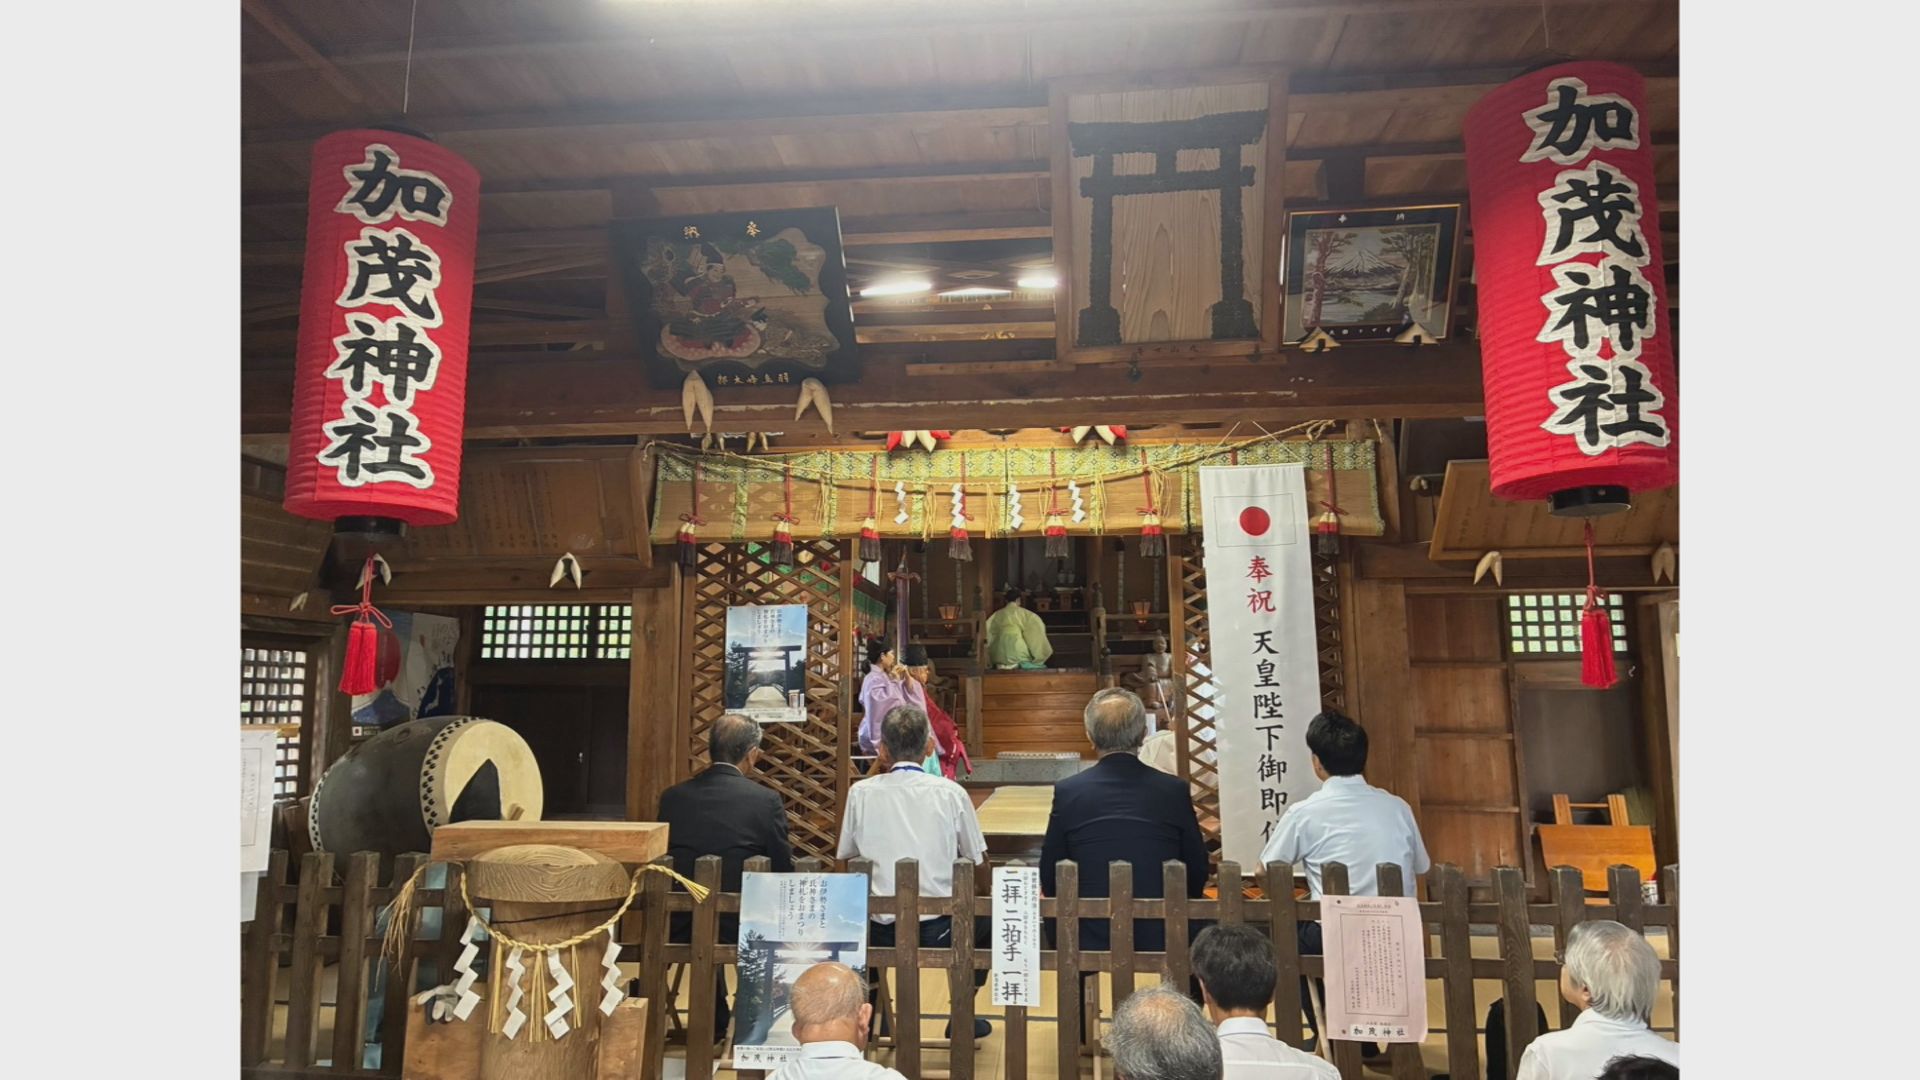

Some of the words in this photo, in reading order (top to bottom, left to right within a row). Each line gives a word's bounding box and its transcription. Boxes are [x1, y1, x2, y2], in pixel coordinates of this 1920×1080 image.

[325, 149, 447, 481] 加茂神社
[1536, 84, 1665, 447] 加茂神社
[1245, 554, 1276, 614] 奉祝
[1353, 1025, 1406, 1037] 加茂神社
